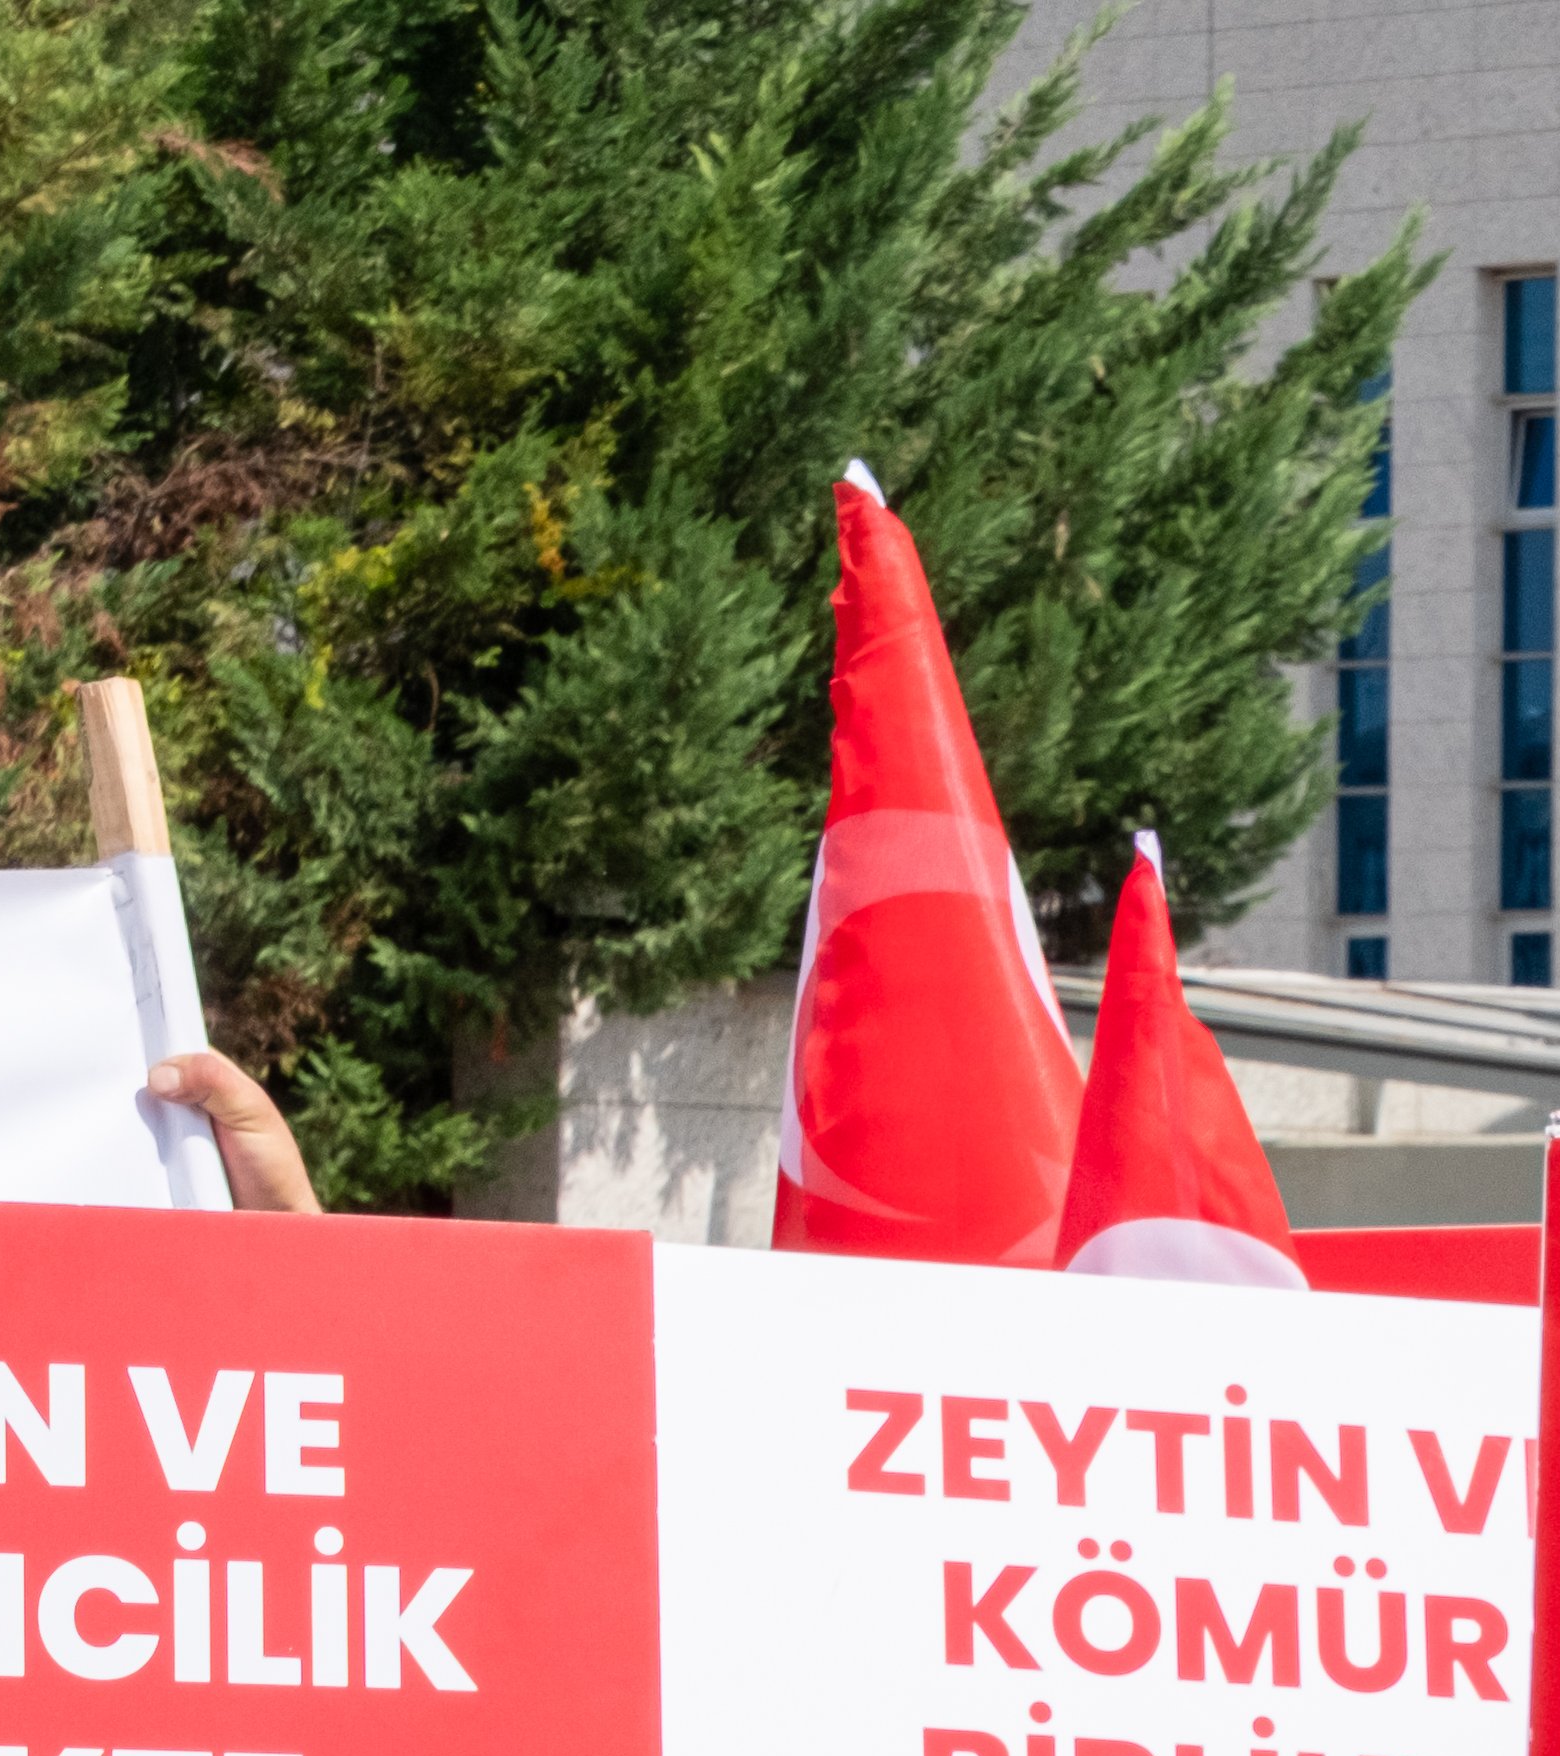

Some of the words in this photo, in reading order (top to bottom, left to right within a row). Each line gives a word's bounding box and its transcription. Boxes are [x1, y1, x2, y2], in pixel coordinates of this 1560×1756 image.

[127, 1365, 346, 1497] VE
[845, 1384, 1370, 1527] ZEYTİN
[1407, 1429, 1538, 1538] V
[943, 1537, 1510, 1702] KÖMÜR
